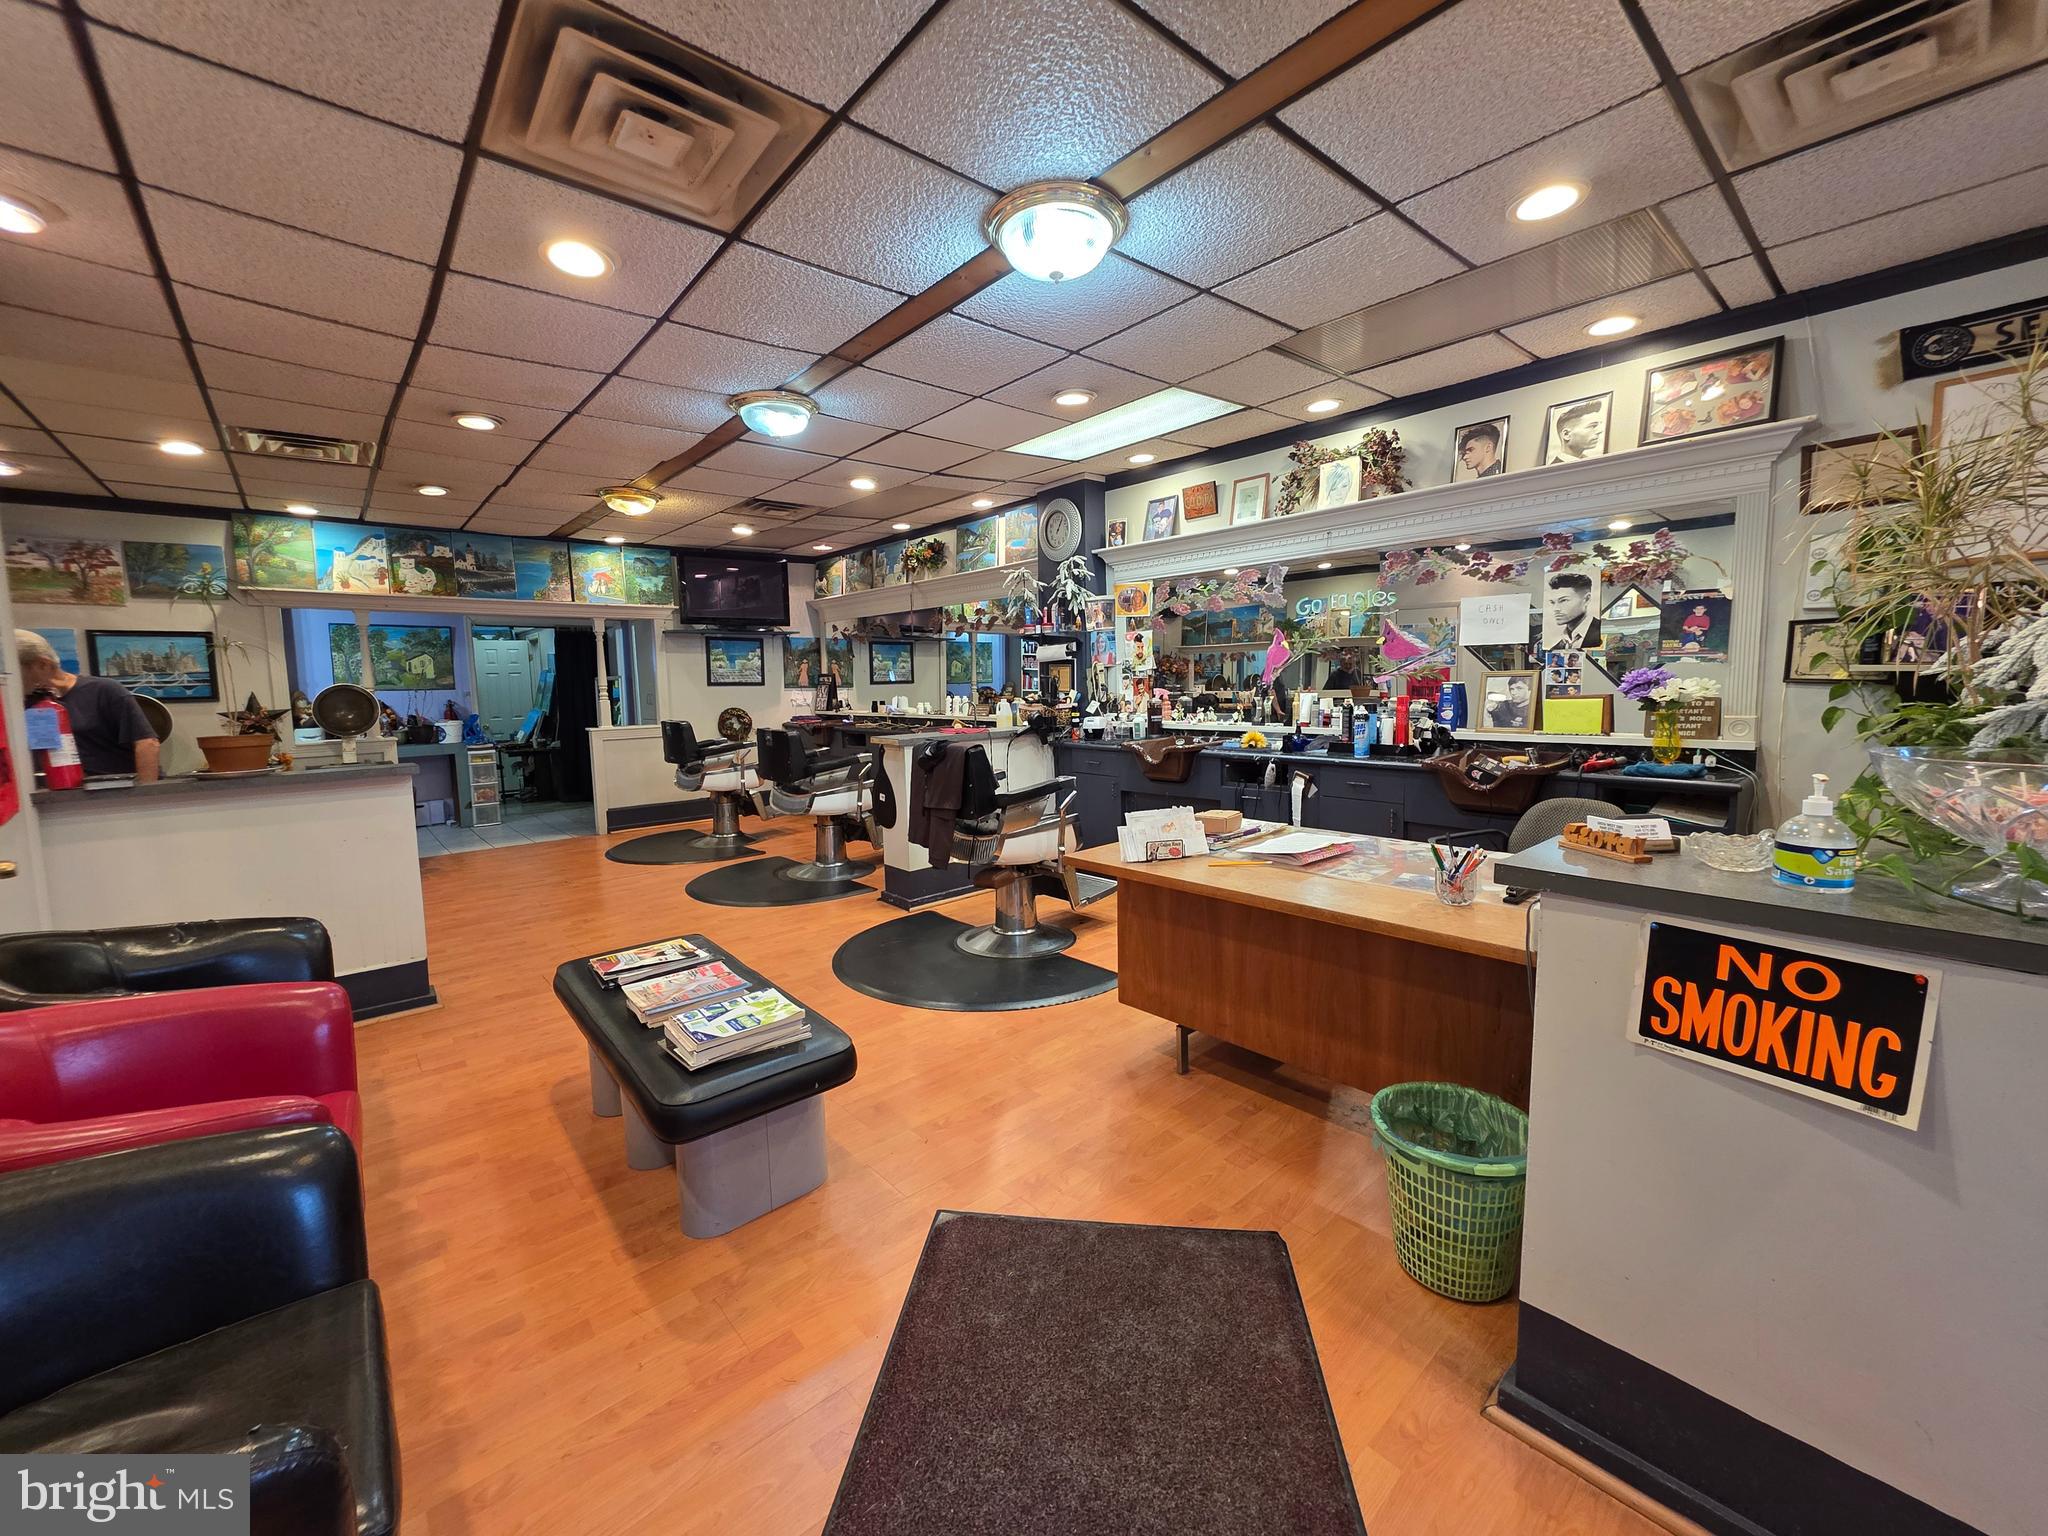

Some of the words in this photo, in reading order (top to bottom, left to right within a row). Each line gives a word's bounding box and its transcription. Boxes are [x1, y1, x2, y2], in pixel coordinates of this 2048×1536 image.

[1996, 311, 2048, 346] SE
[1479, 603, 1504, 613] CASH
[1717, 944, 1841, 1001] NO
[1651, 976, 1902, 1099] SMOKING
